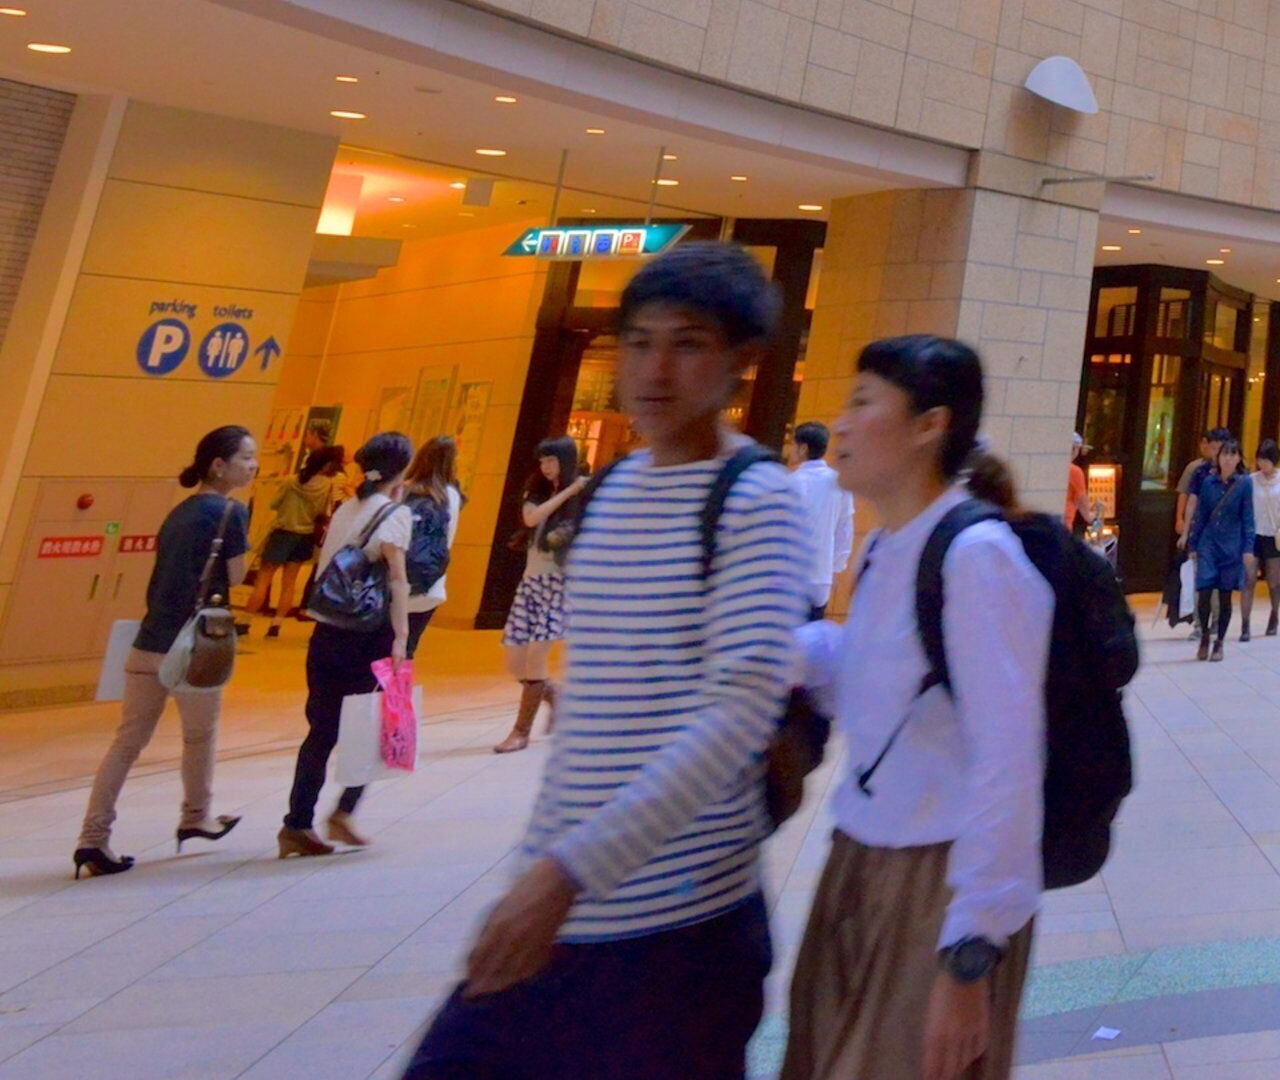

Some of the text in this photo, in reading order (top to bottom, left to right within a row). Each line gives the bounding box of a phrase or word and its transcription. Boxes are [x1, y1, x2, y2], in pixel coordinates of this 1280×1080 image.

[149, 298, 253, 319] parking toilets
[147, 325, 184, 367] P
